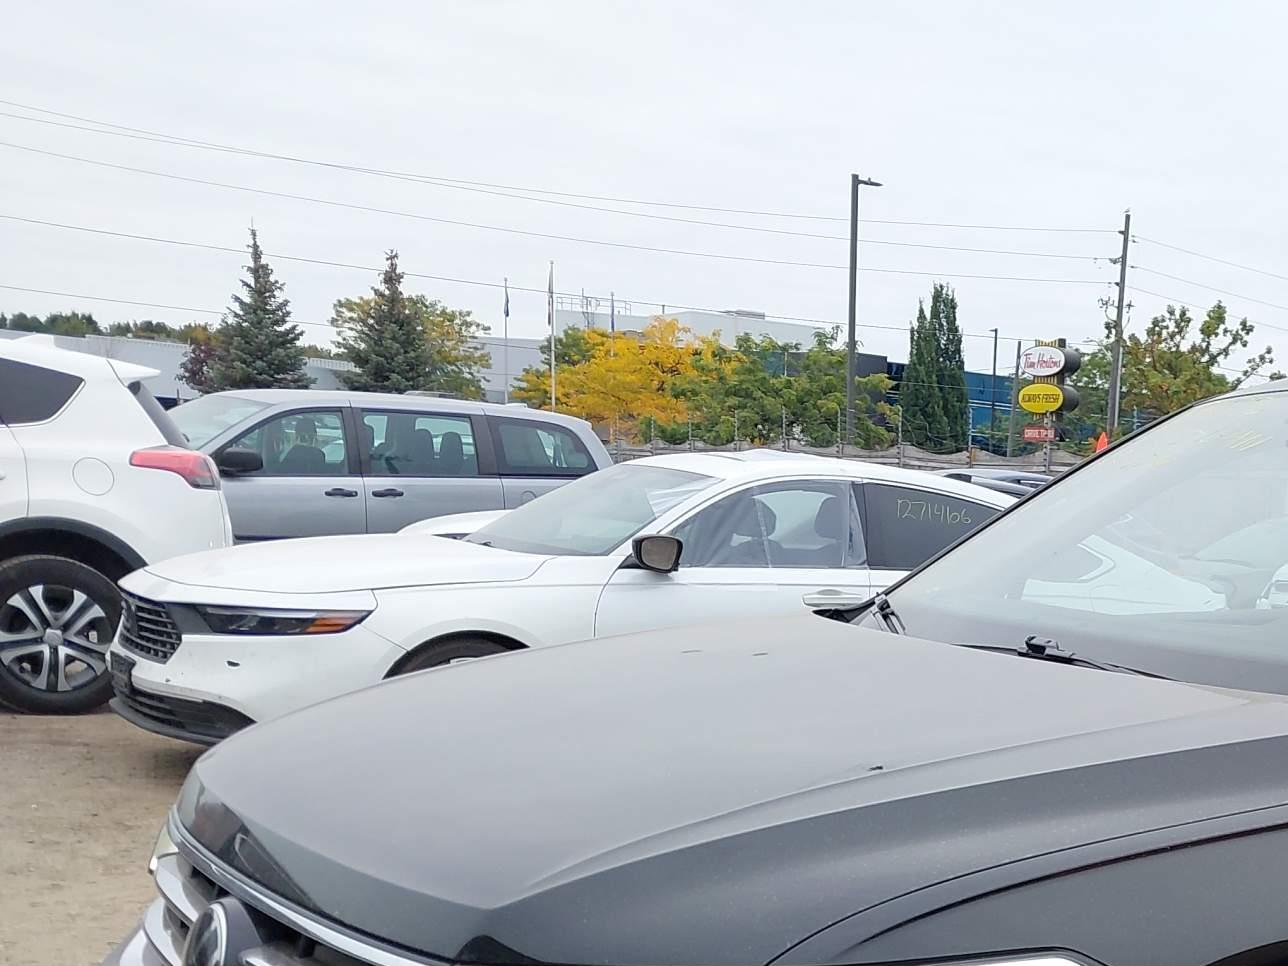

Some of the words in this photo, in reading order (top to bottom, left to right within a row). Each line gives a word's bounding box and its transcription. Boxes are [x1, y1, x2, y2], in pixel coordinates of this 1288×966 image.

[1024, 353, 1036, 370] Tim
[1037, 352, 1061, 369] Hortons
[1041, 393, 1060, 404] FRESH
